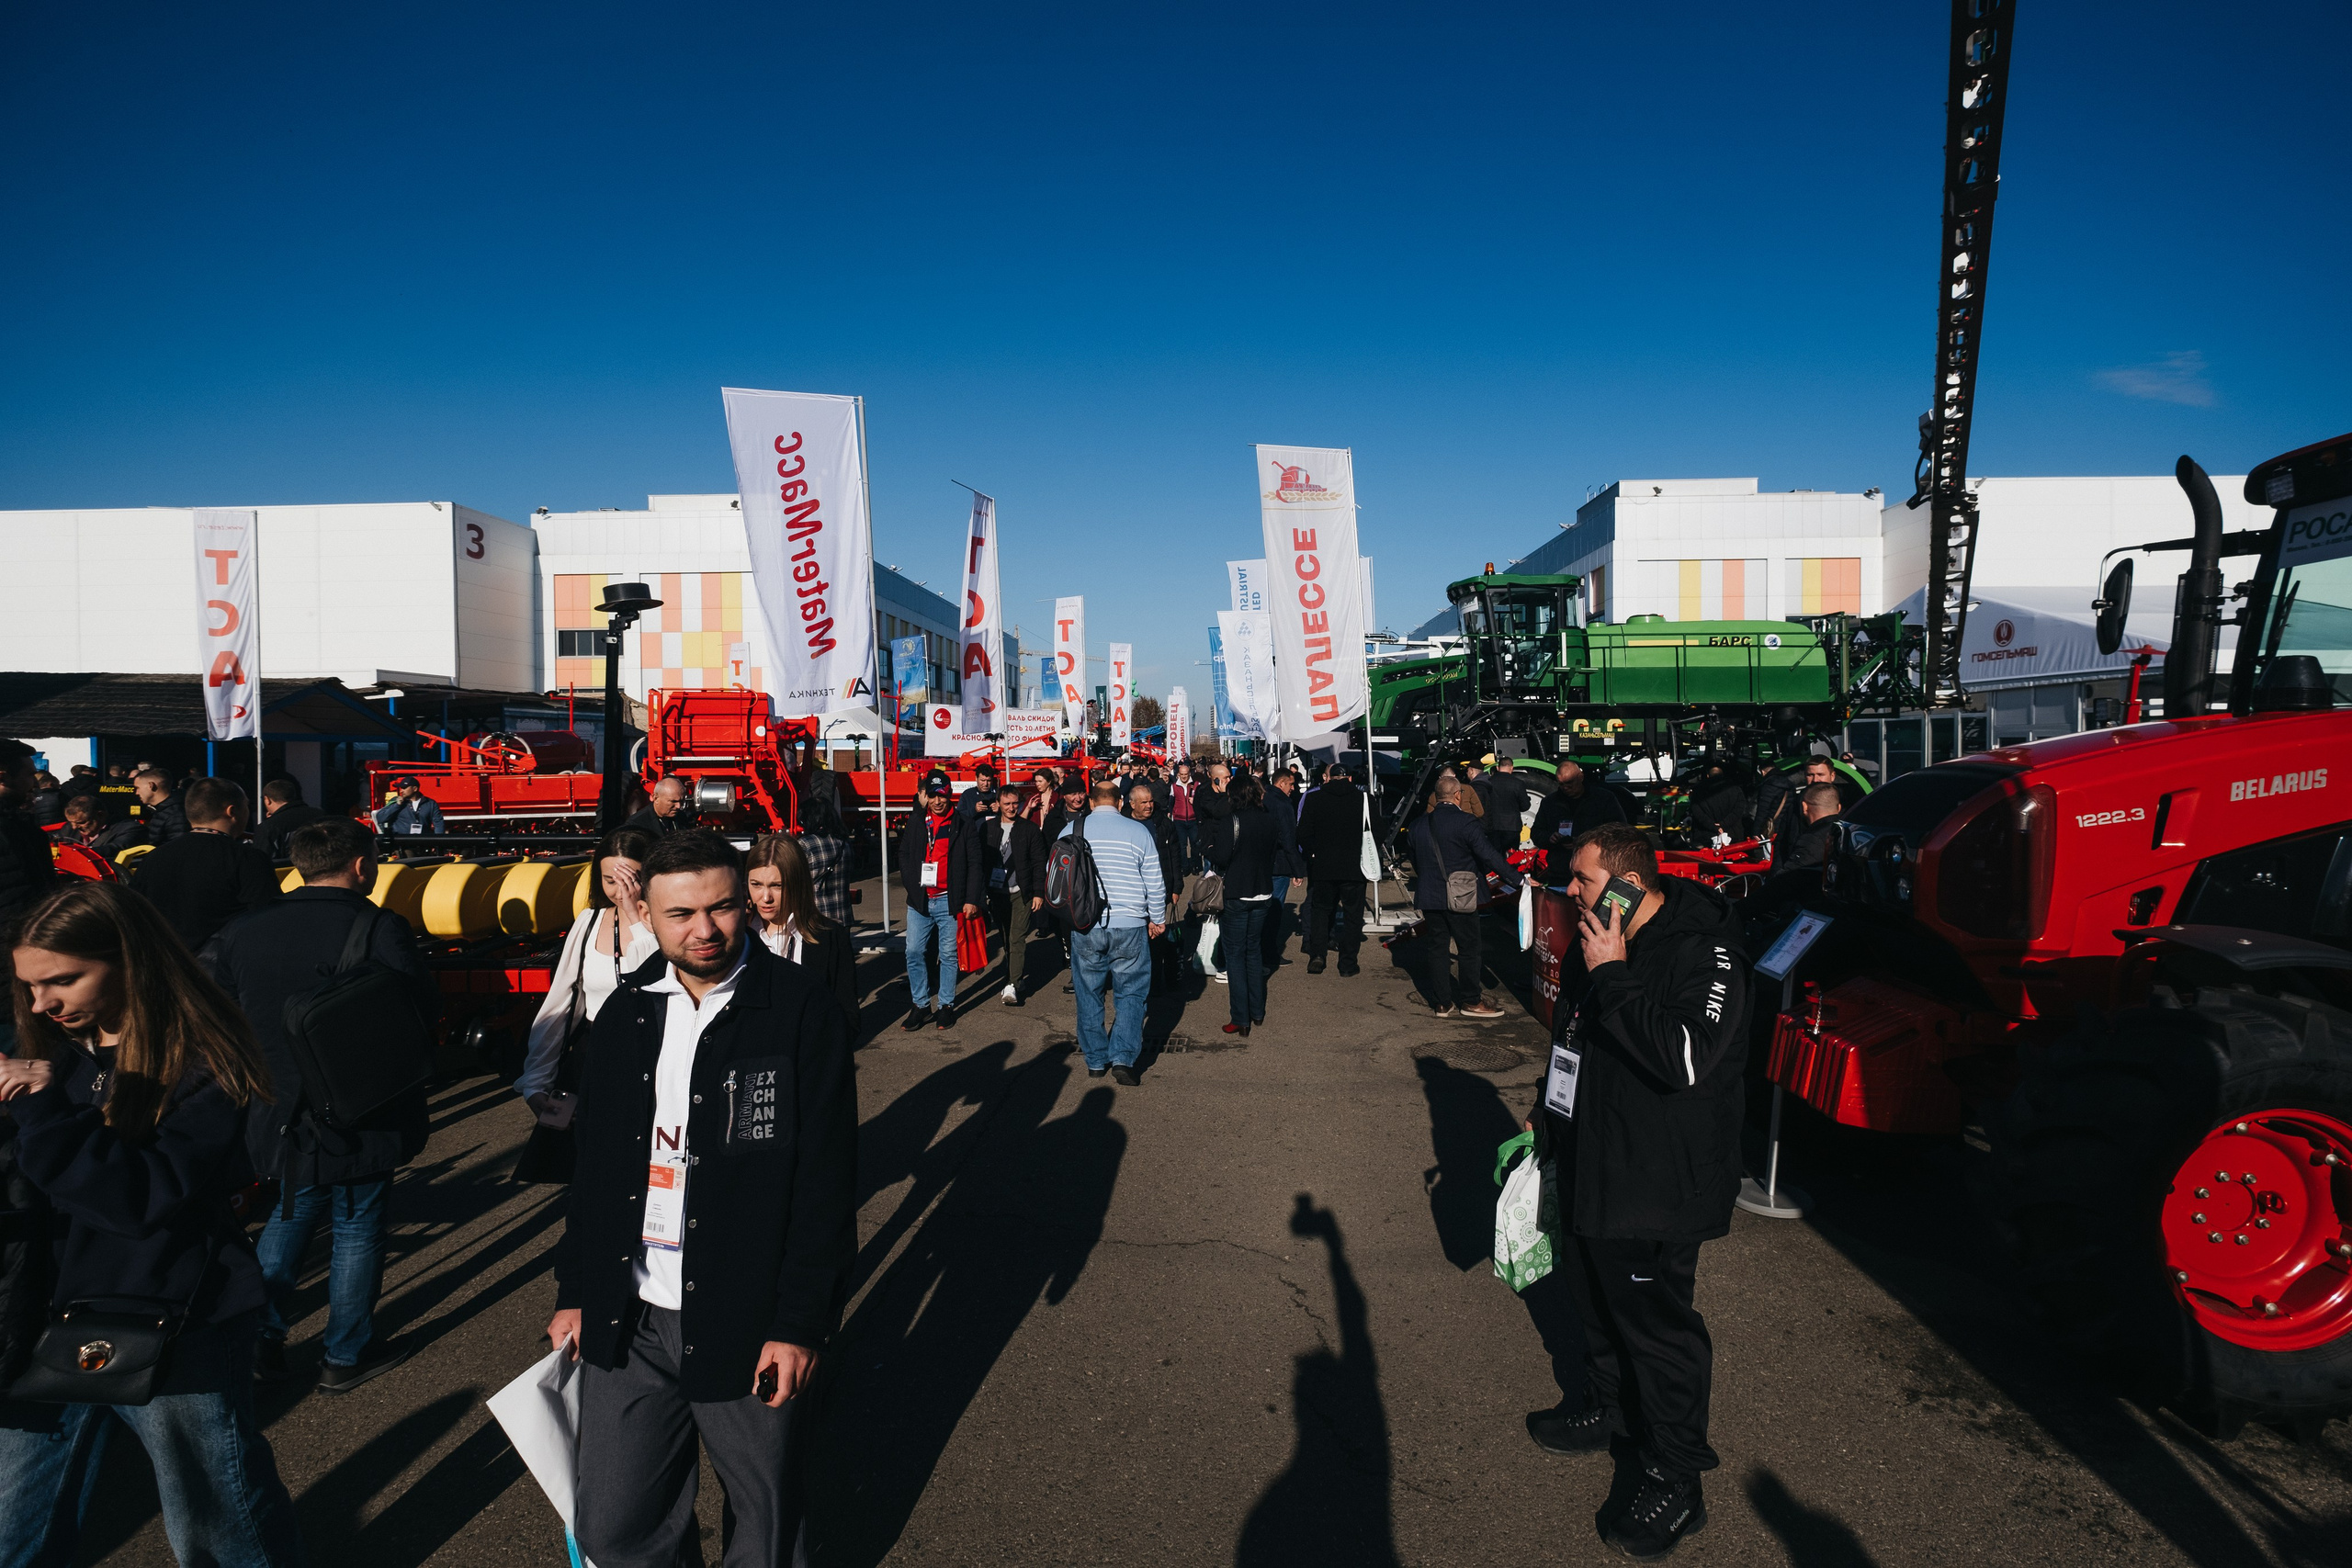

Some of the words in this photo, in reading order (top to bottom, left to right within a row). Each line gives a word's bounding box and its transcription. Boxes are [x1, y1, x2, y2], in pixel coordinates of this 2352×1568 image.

[466, 523, 485, 560] 3
[1708, 636, 1752, 647] БАРС
[1971, 646, 2038, 663] ГОМСЕЛЬМАШ
[1007, 714, 1026, 722] ВАЛЬ
[1027, 715, 1056, 723] СКИДОК
[1170, 703, 1180, 761] ИРОВЕЦ
[2230, 768, 2328, 802] BELARUS
[2075, 807, 2145, 828] 1222.3
[1366, 837, 1378, 874] betaren.ru
[1199, 929, 1207, 961] etaren.ru
[1713, 946, 1732, 971] AIR
[1534, 974, 1561, 1002] ЛЕСС
[1705, 981, 1727, 1023] NIKE
[756, 1070, 777, 1087] EX
[738, 1073, 757, 1141] ARMANI
[752, 1088, 775, 1104] CH
[752, 1105, 775, 1122] AN
[752, 1123, 775, 1140] GE
[1672, 1508, 1690, 1529] Columbia
